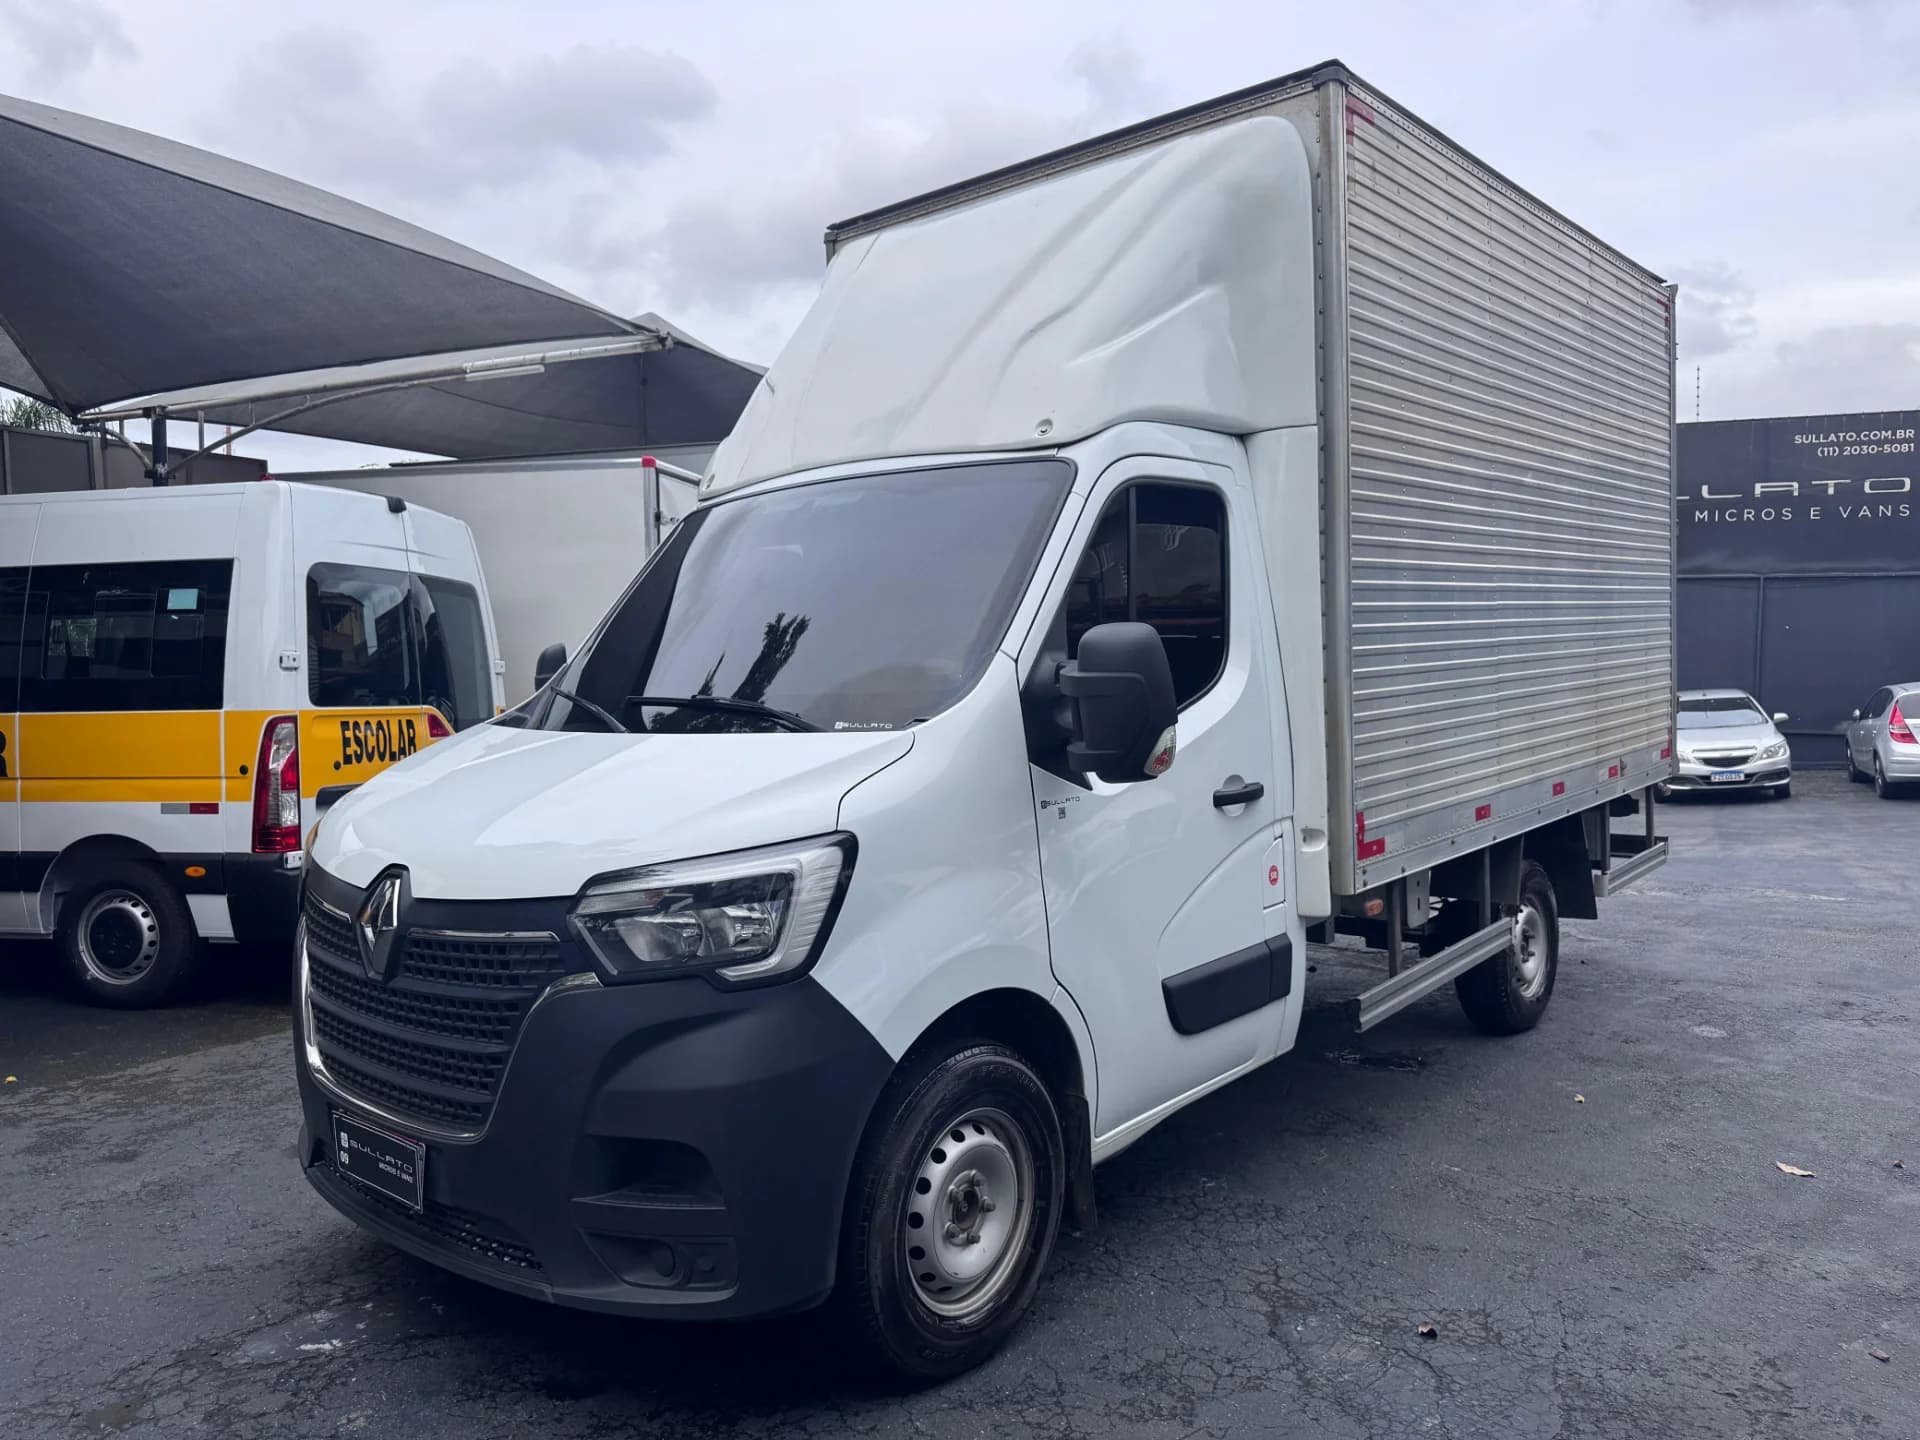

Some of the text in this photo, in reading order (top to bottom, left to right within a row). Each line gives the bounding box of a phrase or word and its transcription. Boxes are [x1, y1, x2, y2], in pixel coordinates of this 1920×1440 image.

[1794, 429, 1915, 444] SULLATO.COM.BR
[1817, 443, 1915, 457] (11) 2030-5081
[1695, 504, 1910, 523] MICROS E VANS
[340, 719, 417, 765] ESCOLAR
[349, 1139, 413, 1174] SULLATO
